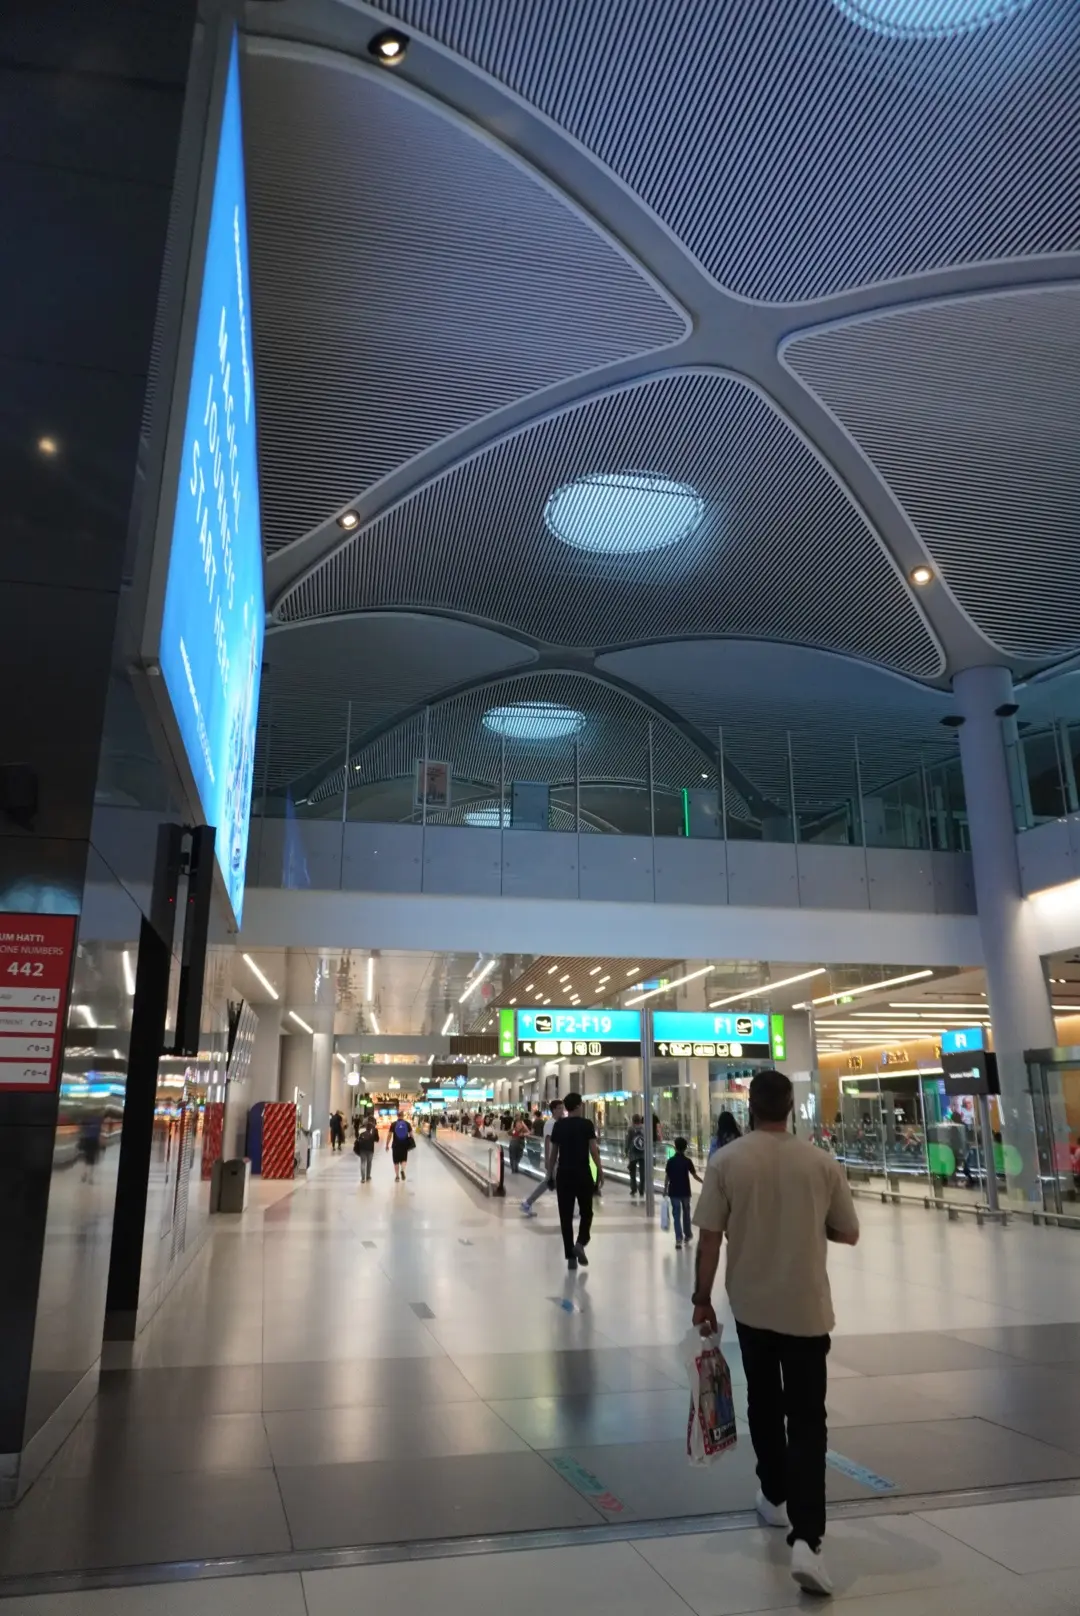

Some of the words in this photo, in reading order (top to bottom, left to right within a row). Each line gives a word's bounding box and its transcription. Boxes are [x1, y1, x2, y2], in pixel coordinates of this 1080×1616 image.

[218, 306, 241, 534] MAGICAL
[204, 374, 236, 610] JOURNEYS
[190, 440, 217, 603] START
[16, 934, 44, 942] HATTI
[21, 946, 64, 955] NUMBERS
[7, 962, 44, 976] 442
[555, 1015, 612, 1034] F2-F19
[714, 1017, 732, 1035] F1
